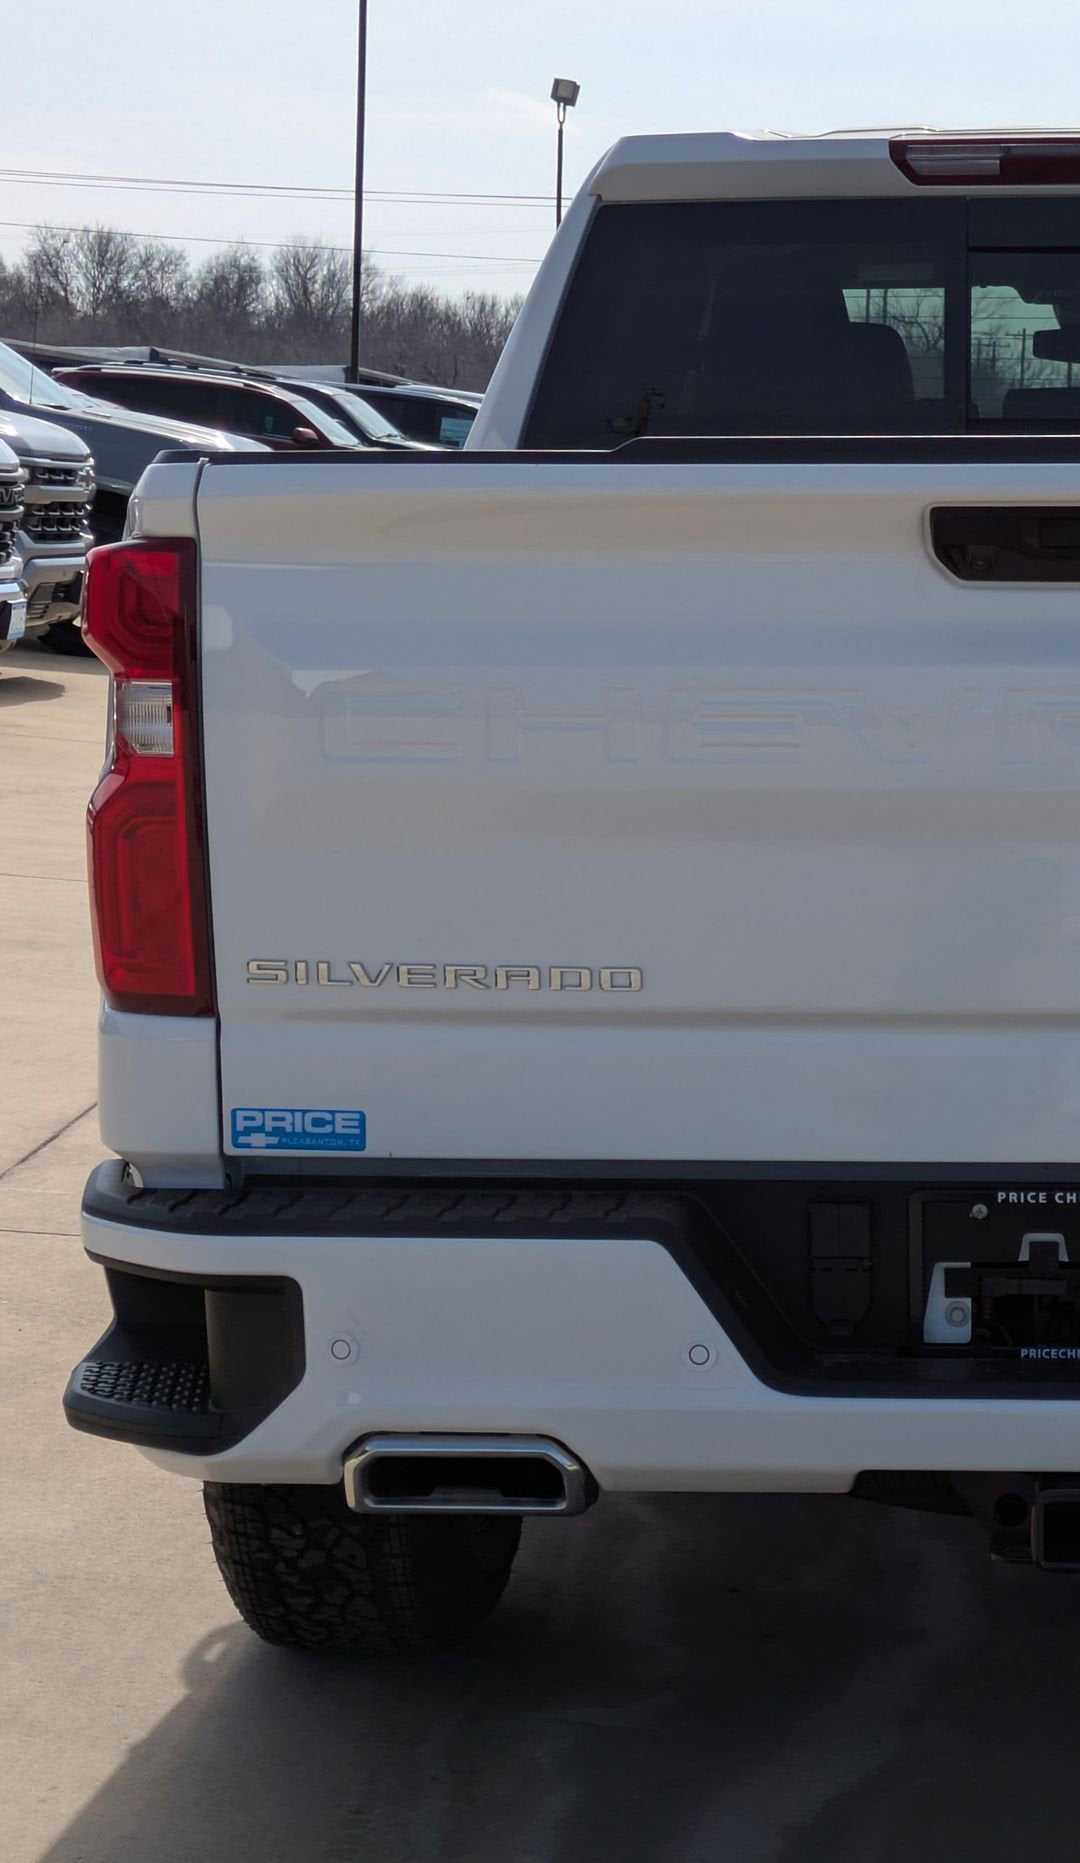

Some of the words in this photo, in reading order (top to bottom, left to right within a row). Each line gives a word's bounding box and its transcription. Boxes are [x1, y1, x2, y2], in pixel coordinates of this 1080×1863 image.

[246, 959, 644, 992] SILVERADO
[235, 1110, 361, 1134] PRICE
[997, 1192, 1047, 1203] PRICE
